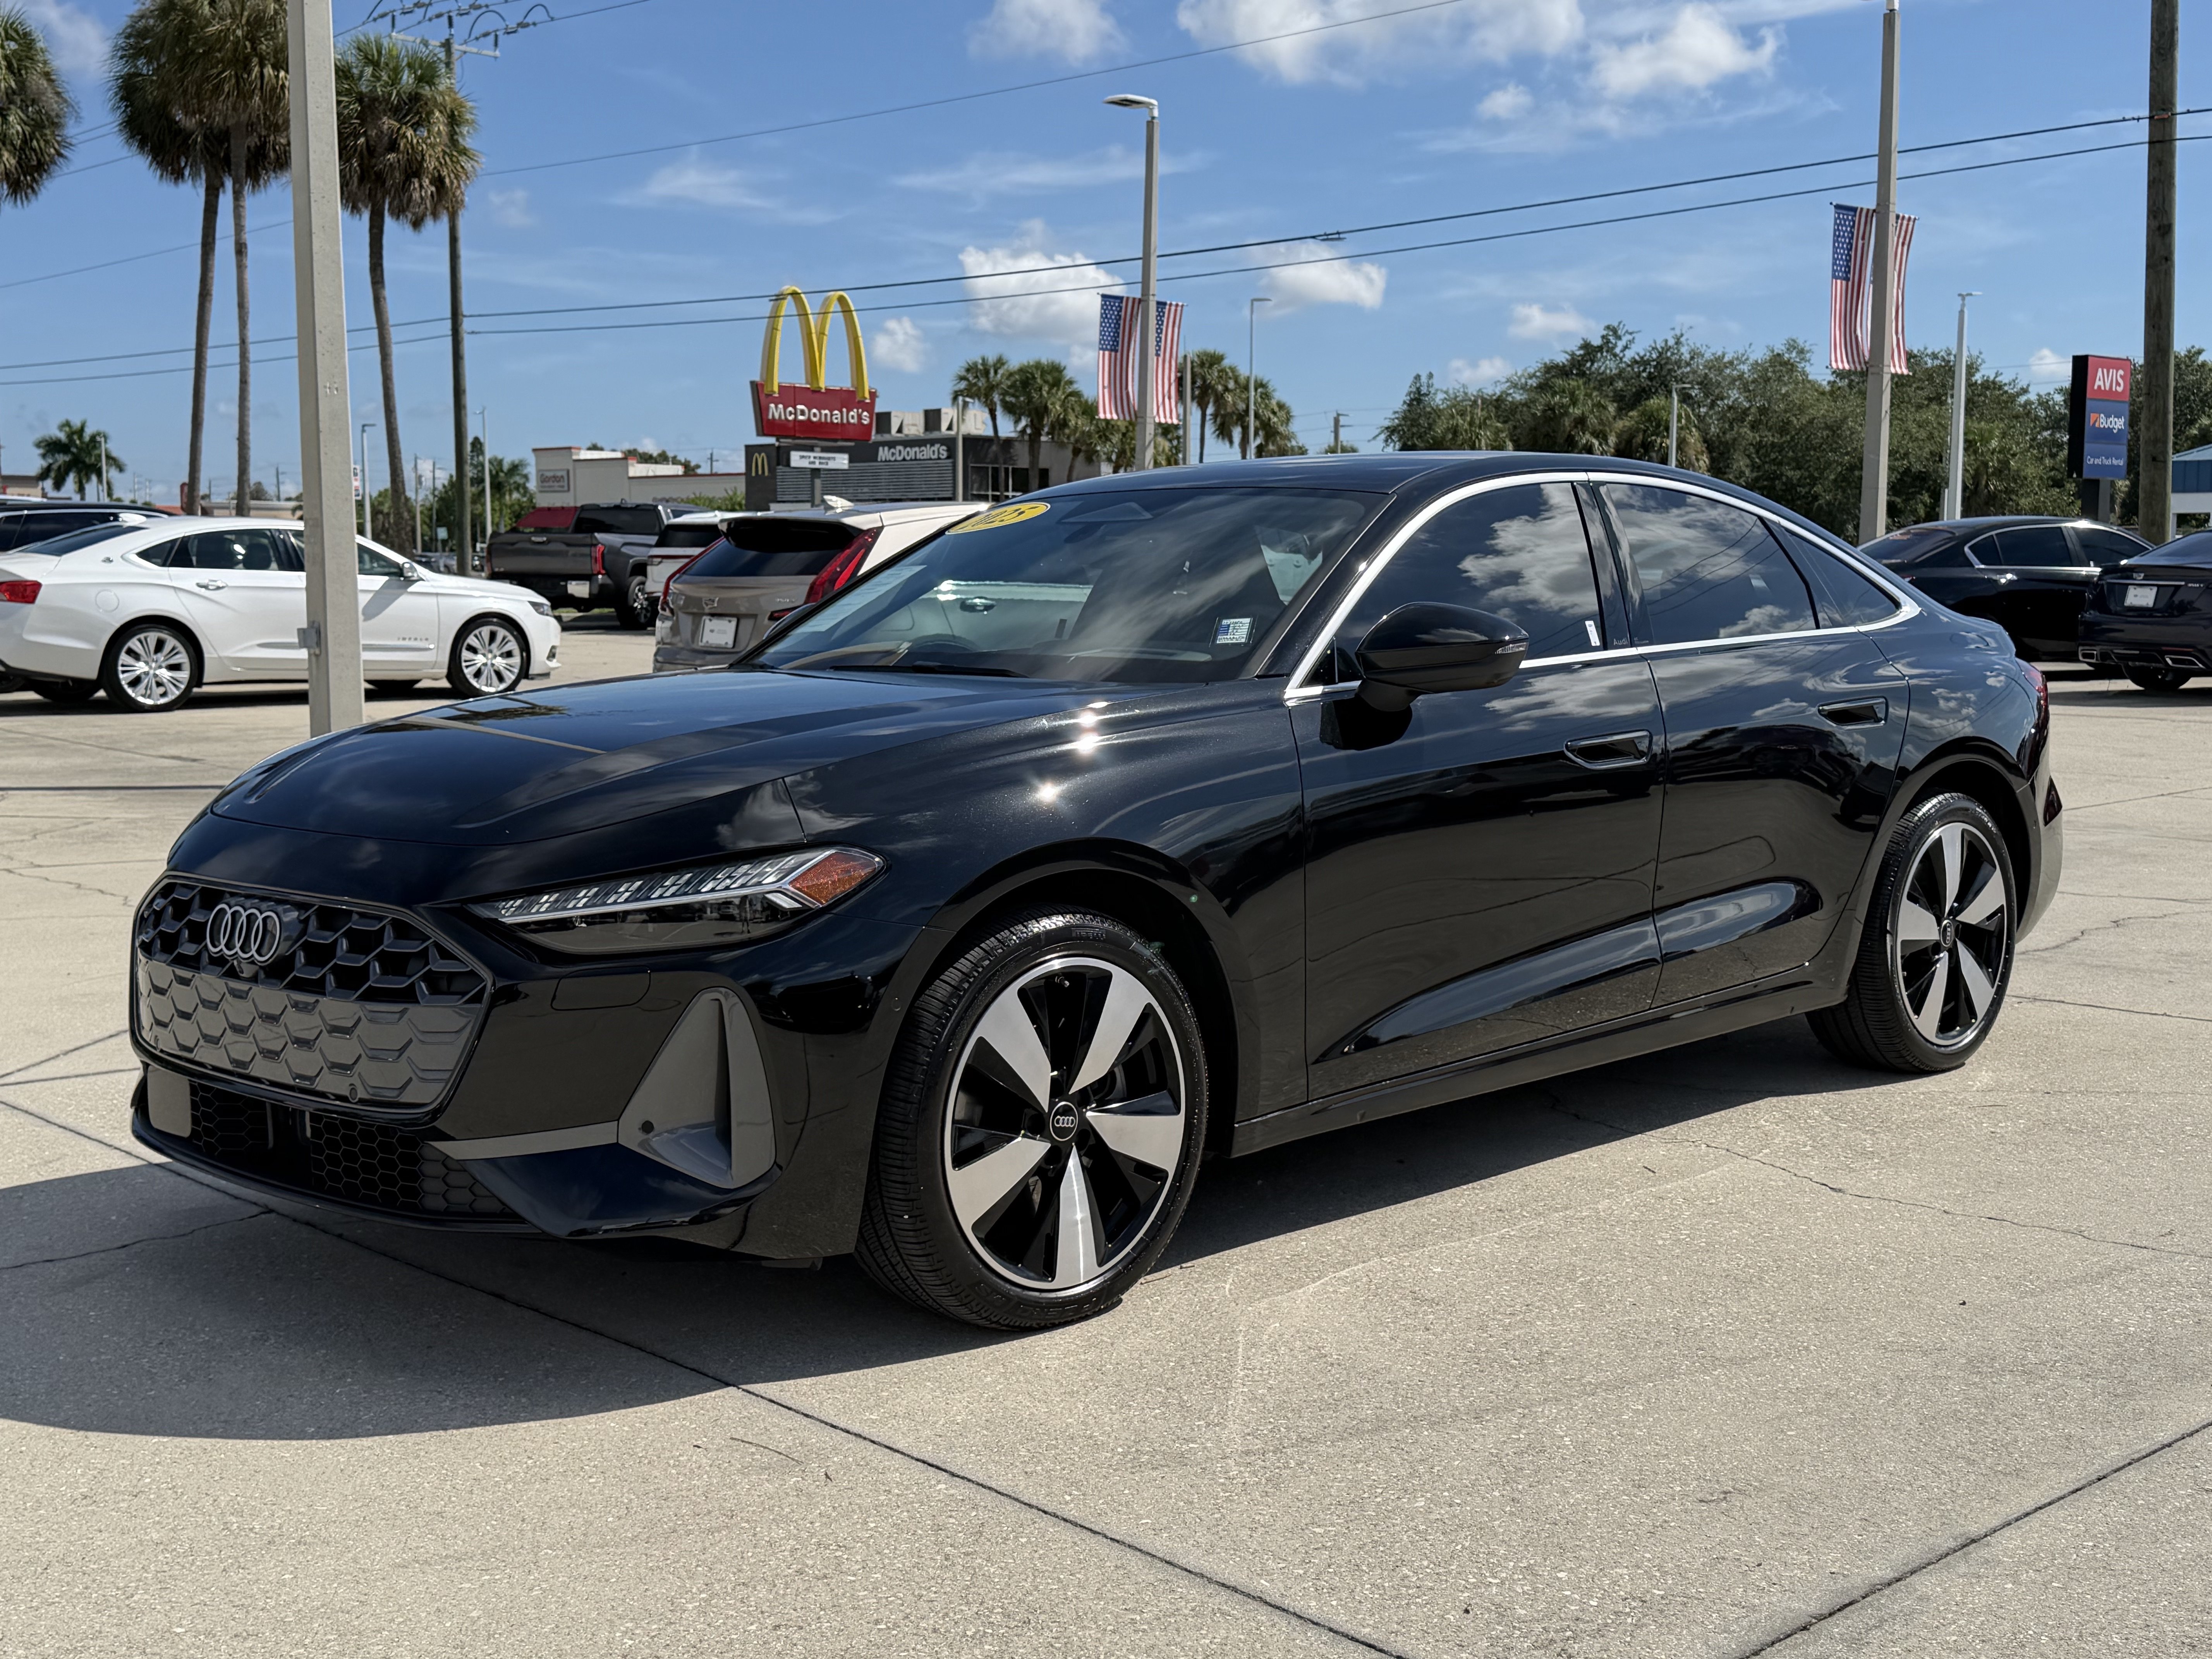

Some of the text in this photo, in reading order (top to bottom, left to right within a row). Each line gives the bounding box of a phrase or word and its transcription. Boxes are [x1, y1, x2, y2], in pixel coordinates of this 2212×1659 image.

[2094, 368, 2124, 392] AVIS
[768, 403, 870, 425] McDonald's
[2100, 414, 2124, 433] Budget
[878, 443, 948, 461] McDonald's
[2102, 456, 2111, 465] Truck
[2112, 457, 2124, 466] Rental
[540, 473, 565, 484] Gordon
[1613, 637, 1628, 646] Audi
